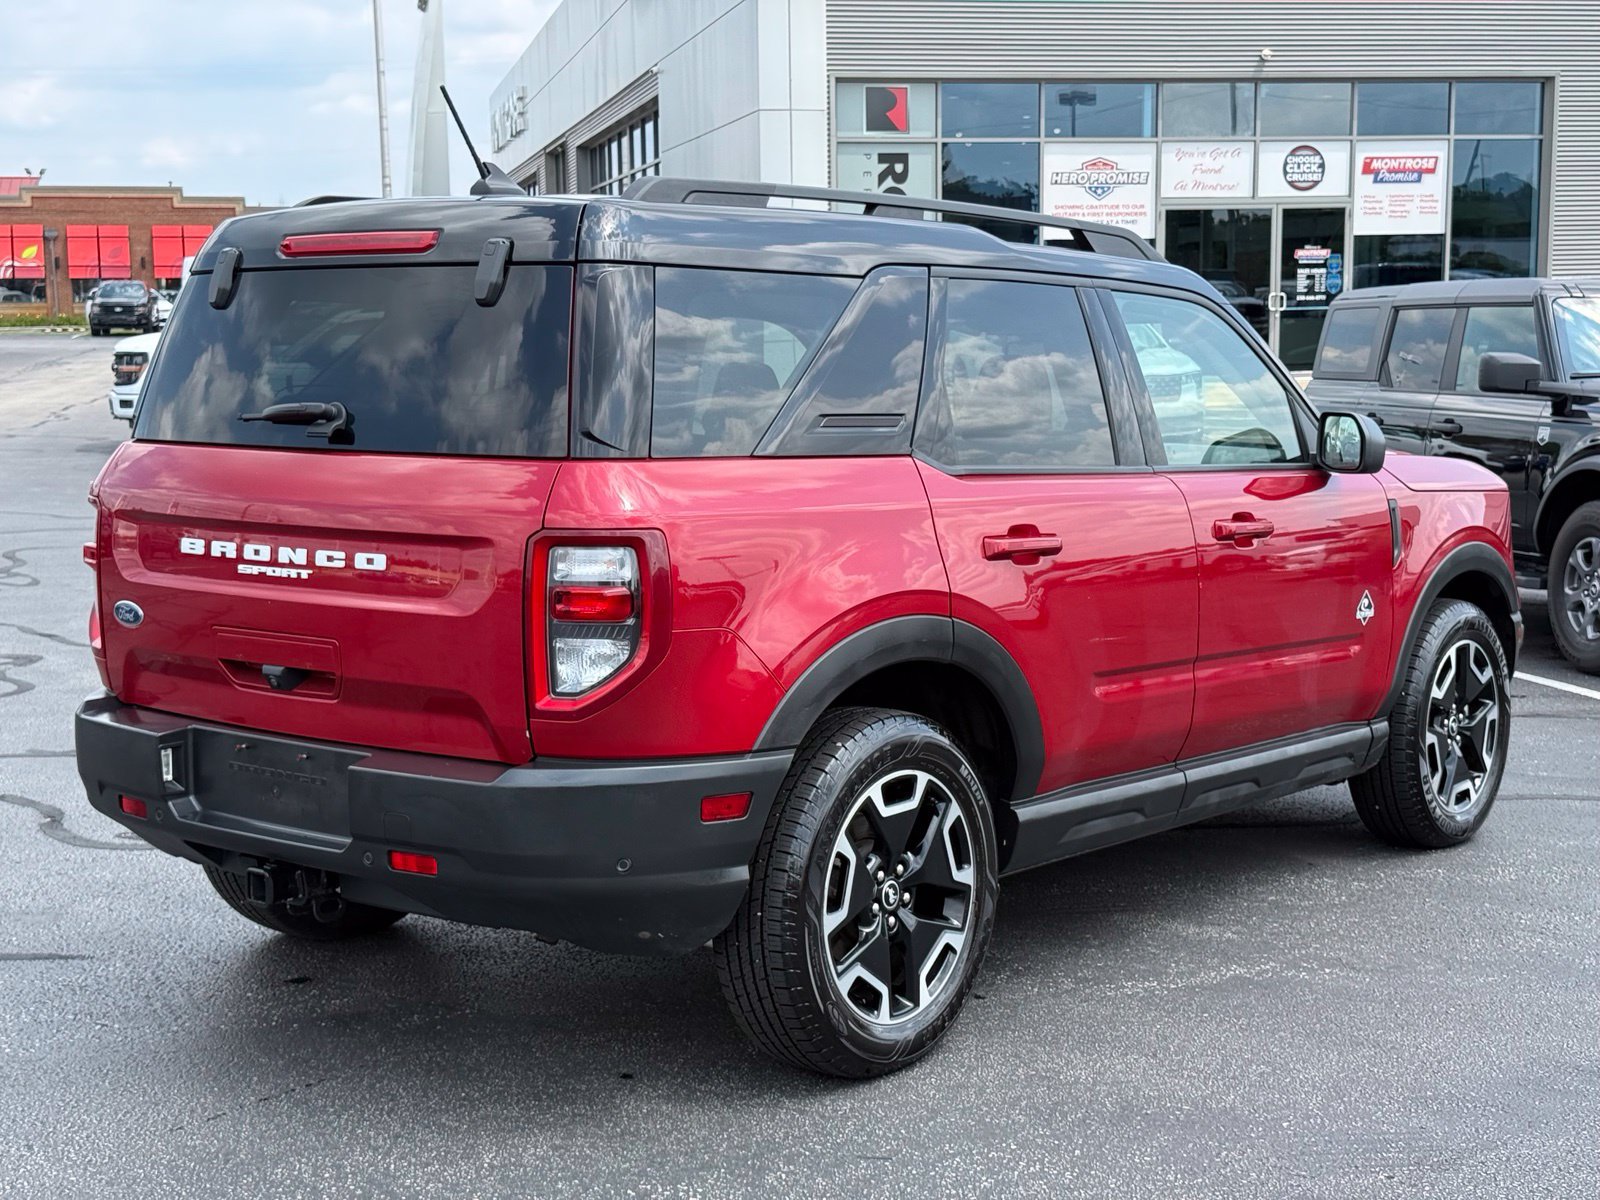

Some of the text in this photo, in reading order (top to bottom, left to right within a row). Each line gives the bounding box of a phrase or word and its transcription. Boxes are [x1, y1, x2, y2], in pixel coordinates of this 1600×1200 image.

[1192, 163, 1224, 175] Friend
[1286, 164, 1322, 172] CLICK.
[1370, 158, 1436, 169] MONTROSE
[1051, 172, 1149, 185] HERO PROMISE
[1286, 173, 1322, 181] CRUISE!
[1377, 170, 1419, 182] Promise
[180, 537, 387, 571] BRONCO
[237, 564, 313, 579] SPORT
[119, 605, 136, 621] Ford
